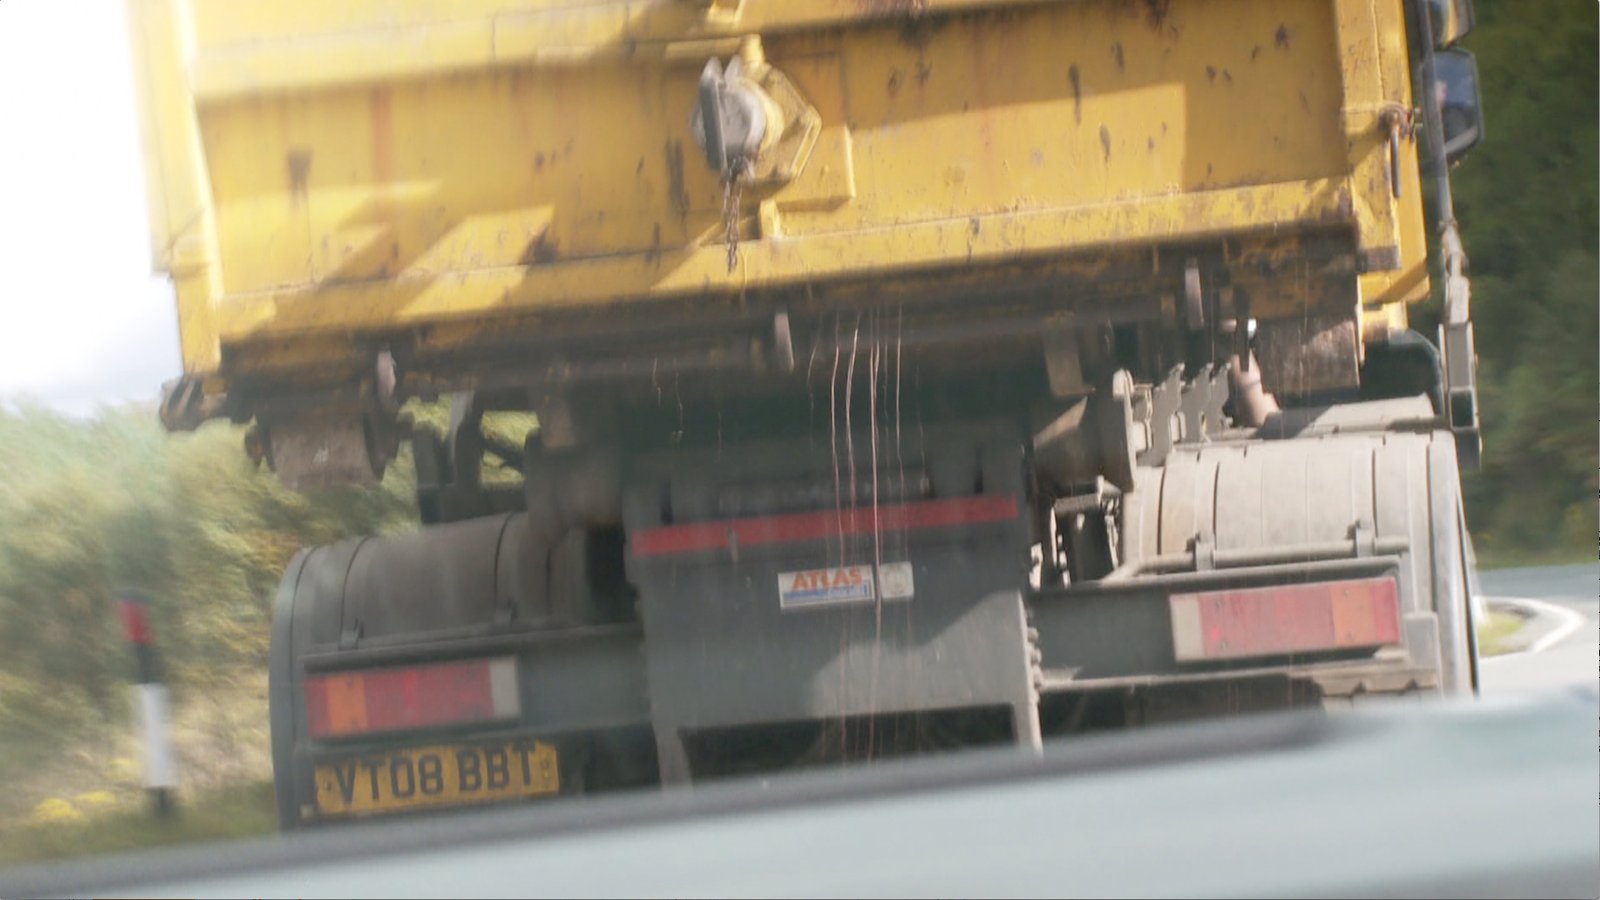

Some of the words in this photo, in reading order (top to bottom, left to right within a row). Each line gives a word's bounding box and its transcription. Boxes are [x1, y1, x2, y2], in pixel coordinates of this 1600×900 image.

[792, 566, 863, 591] ATLAS
[335, 755, 443, 804] VT08
[457, 743, 535, 790] BBT
